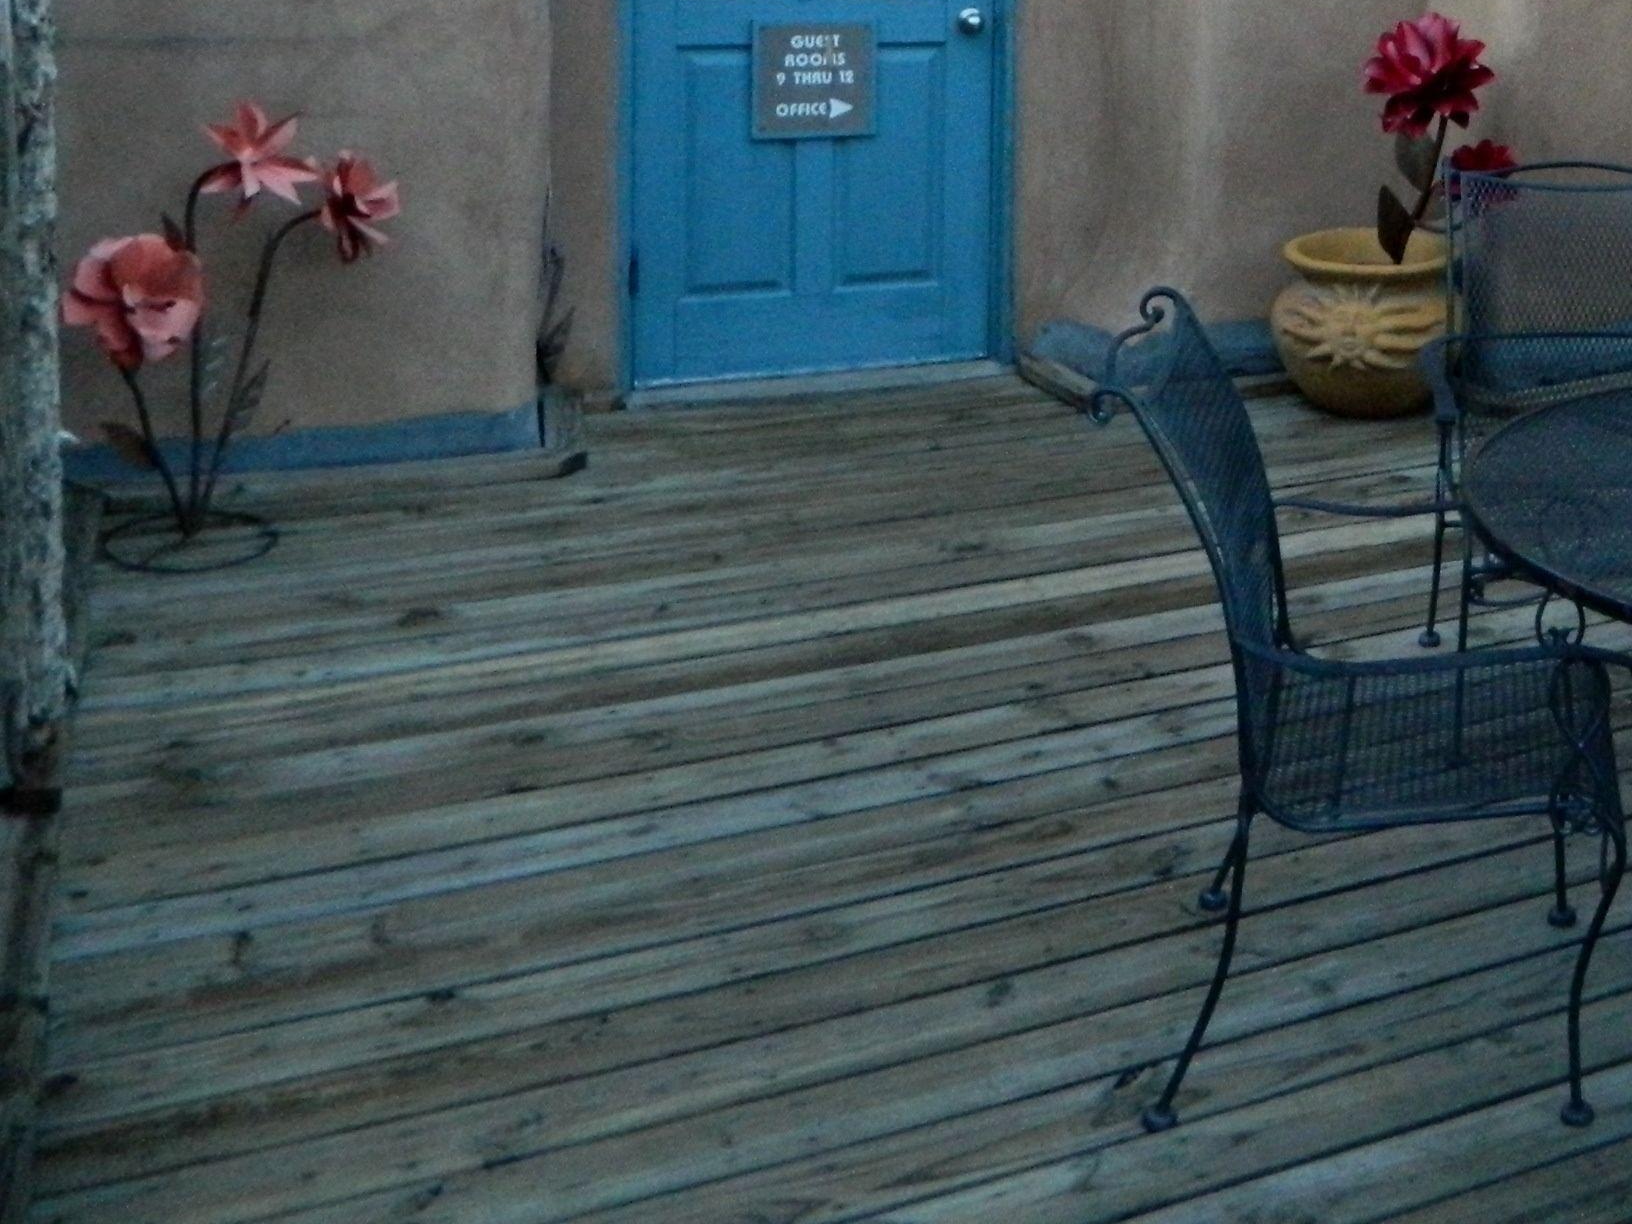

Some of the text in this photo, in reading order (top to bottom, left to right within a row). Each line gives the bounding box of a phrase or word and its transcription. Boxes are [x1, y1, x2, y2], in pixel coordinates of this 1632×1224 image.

[791, 34, 840, 49] GUET
[776, 70, 854, 85] 9 THRU 12
[776, 102, 827, 117] OFFICE
